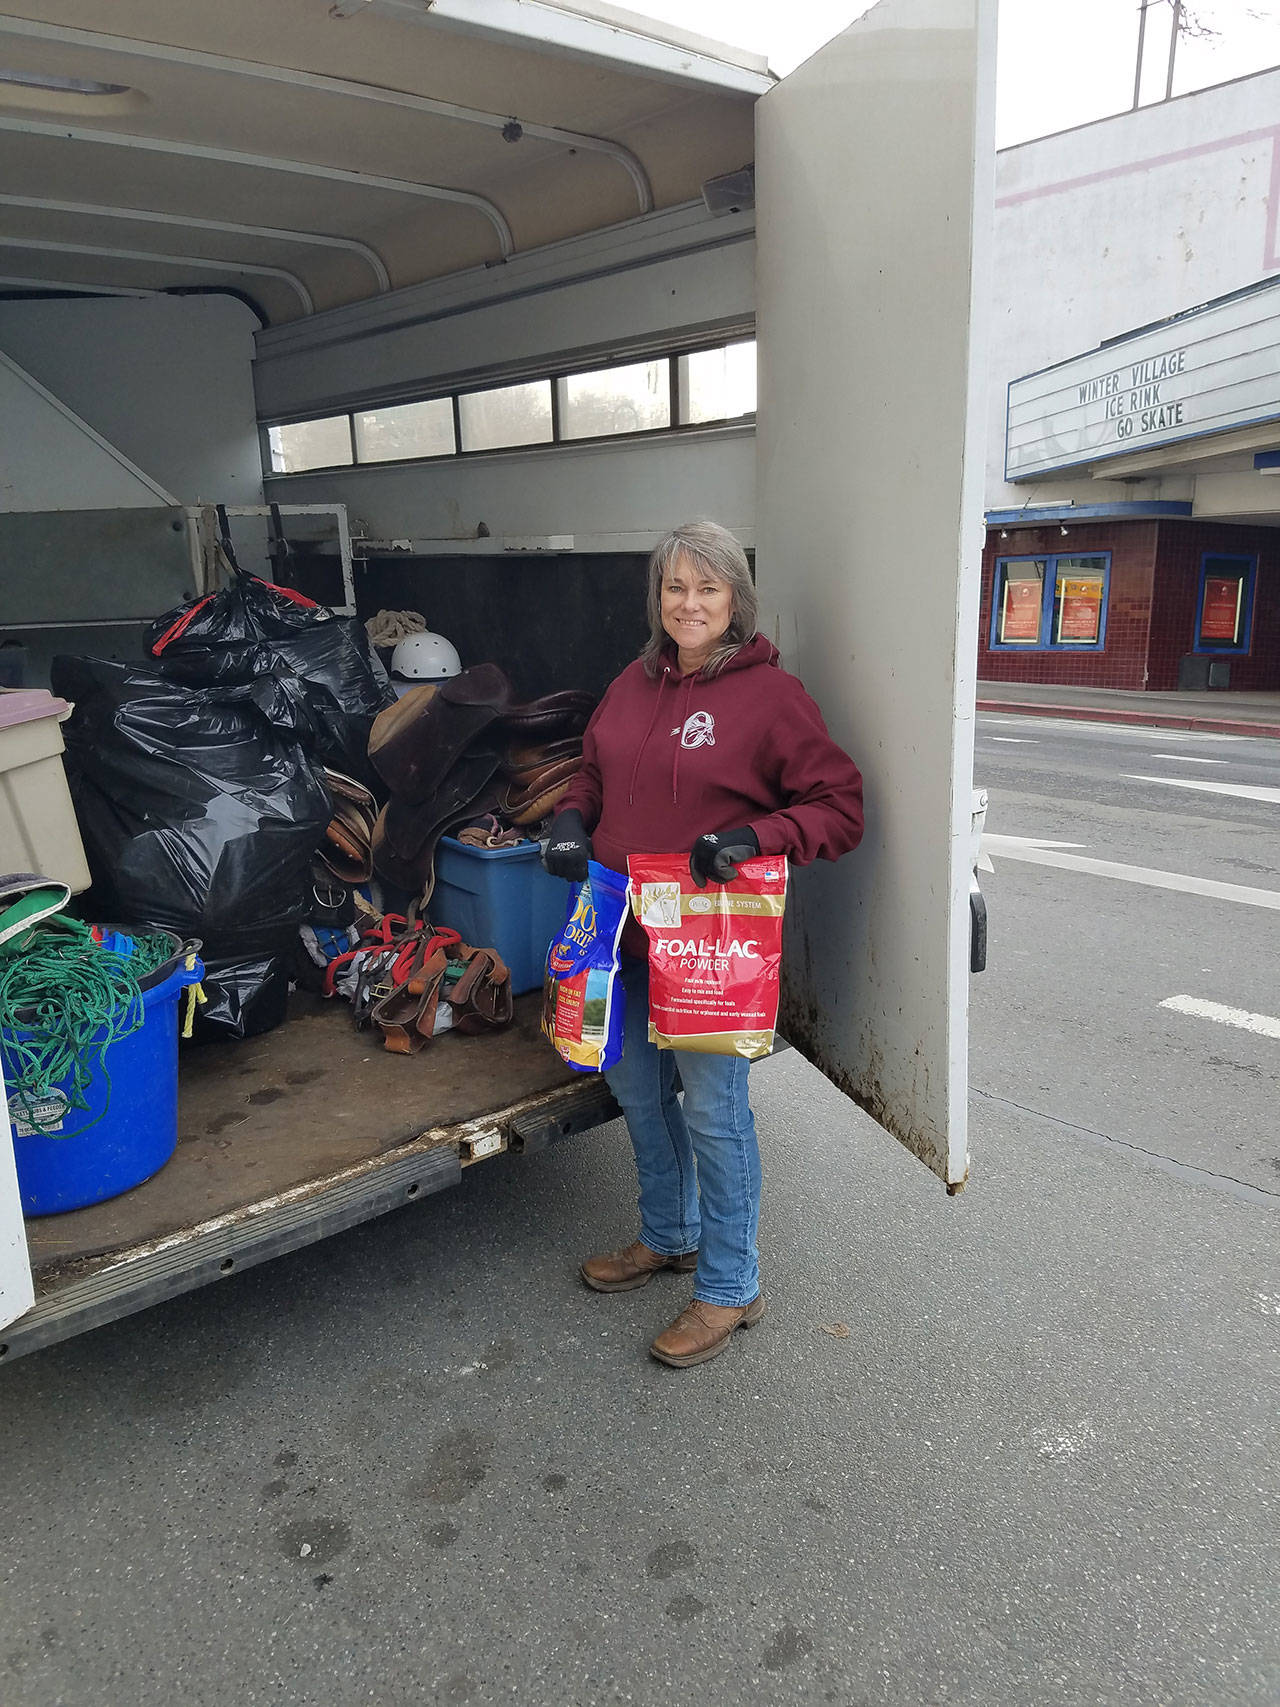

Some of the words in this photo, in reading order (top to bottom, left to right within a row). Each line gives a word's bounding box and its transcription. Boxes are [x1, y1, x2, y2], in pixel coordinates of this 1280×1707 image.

[1079, 374, 1120, 405] WINTER
[1131, 351, 1186, 387] VILLAGE
[1105, 396, 1124, 420] ICE
[1129, 383, 1161, 412] RINK
[1117, 417, 1133, 439] GO
[1141, 402, 1184, 433] SKATE
[736, 901, 761, 909] SYSTEM
[655, 938, 759, 959] FOAL-LAC
[680, 958, 730, 971] POWDER
